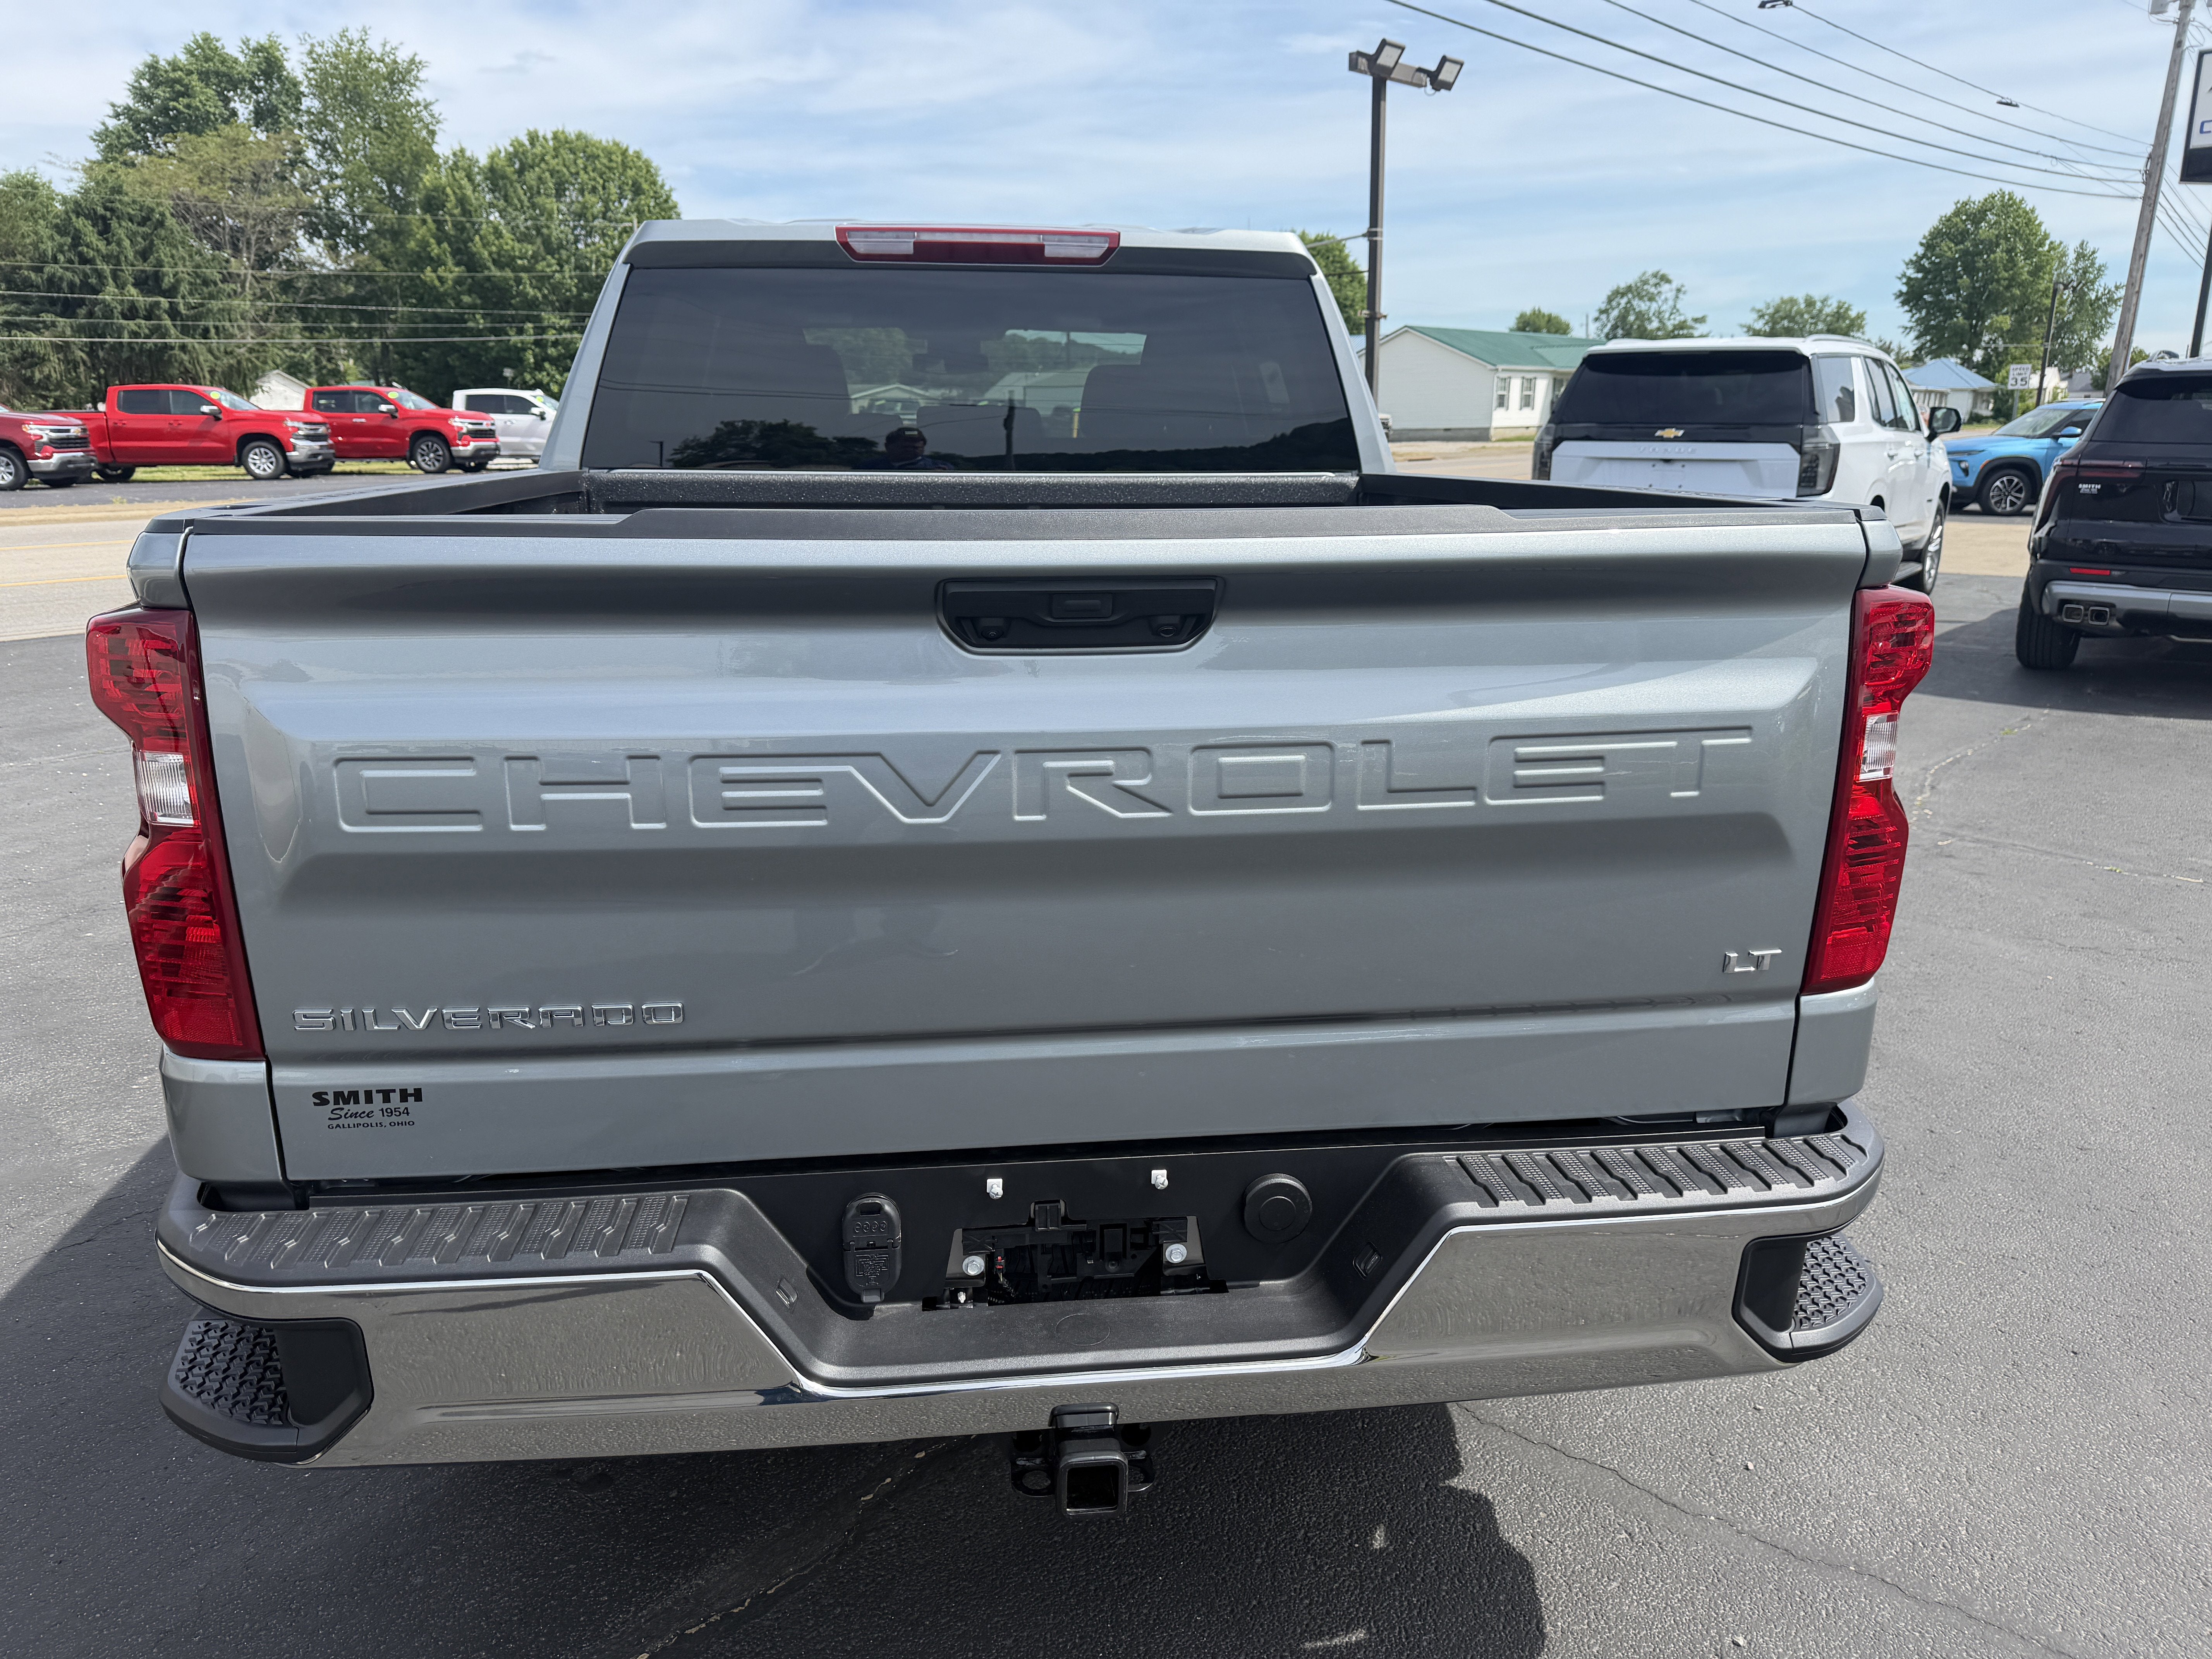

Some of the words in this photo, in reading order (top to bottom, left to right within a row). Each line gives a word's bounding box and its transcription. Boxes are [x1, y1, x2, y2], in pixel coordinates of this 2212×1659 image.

[2010, 376, 2027, 386] 35
[332, 725, 1753, 833] CHEVROLET
[1723, 947, 1782, 973] LT
[292, 1001, 685, 1031] SILVERADO
[312, 1087, 422, 1106] SMITH
[328, 1107, 374, 1121] Since
[378, 1107, 410, 1117] 1954
